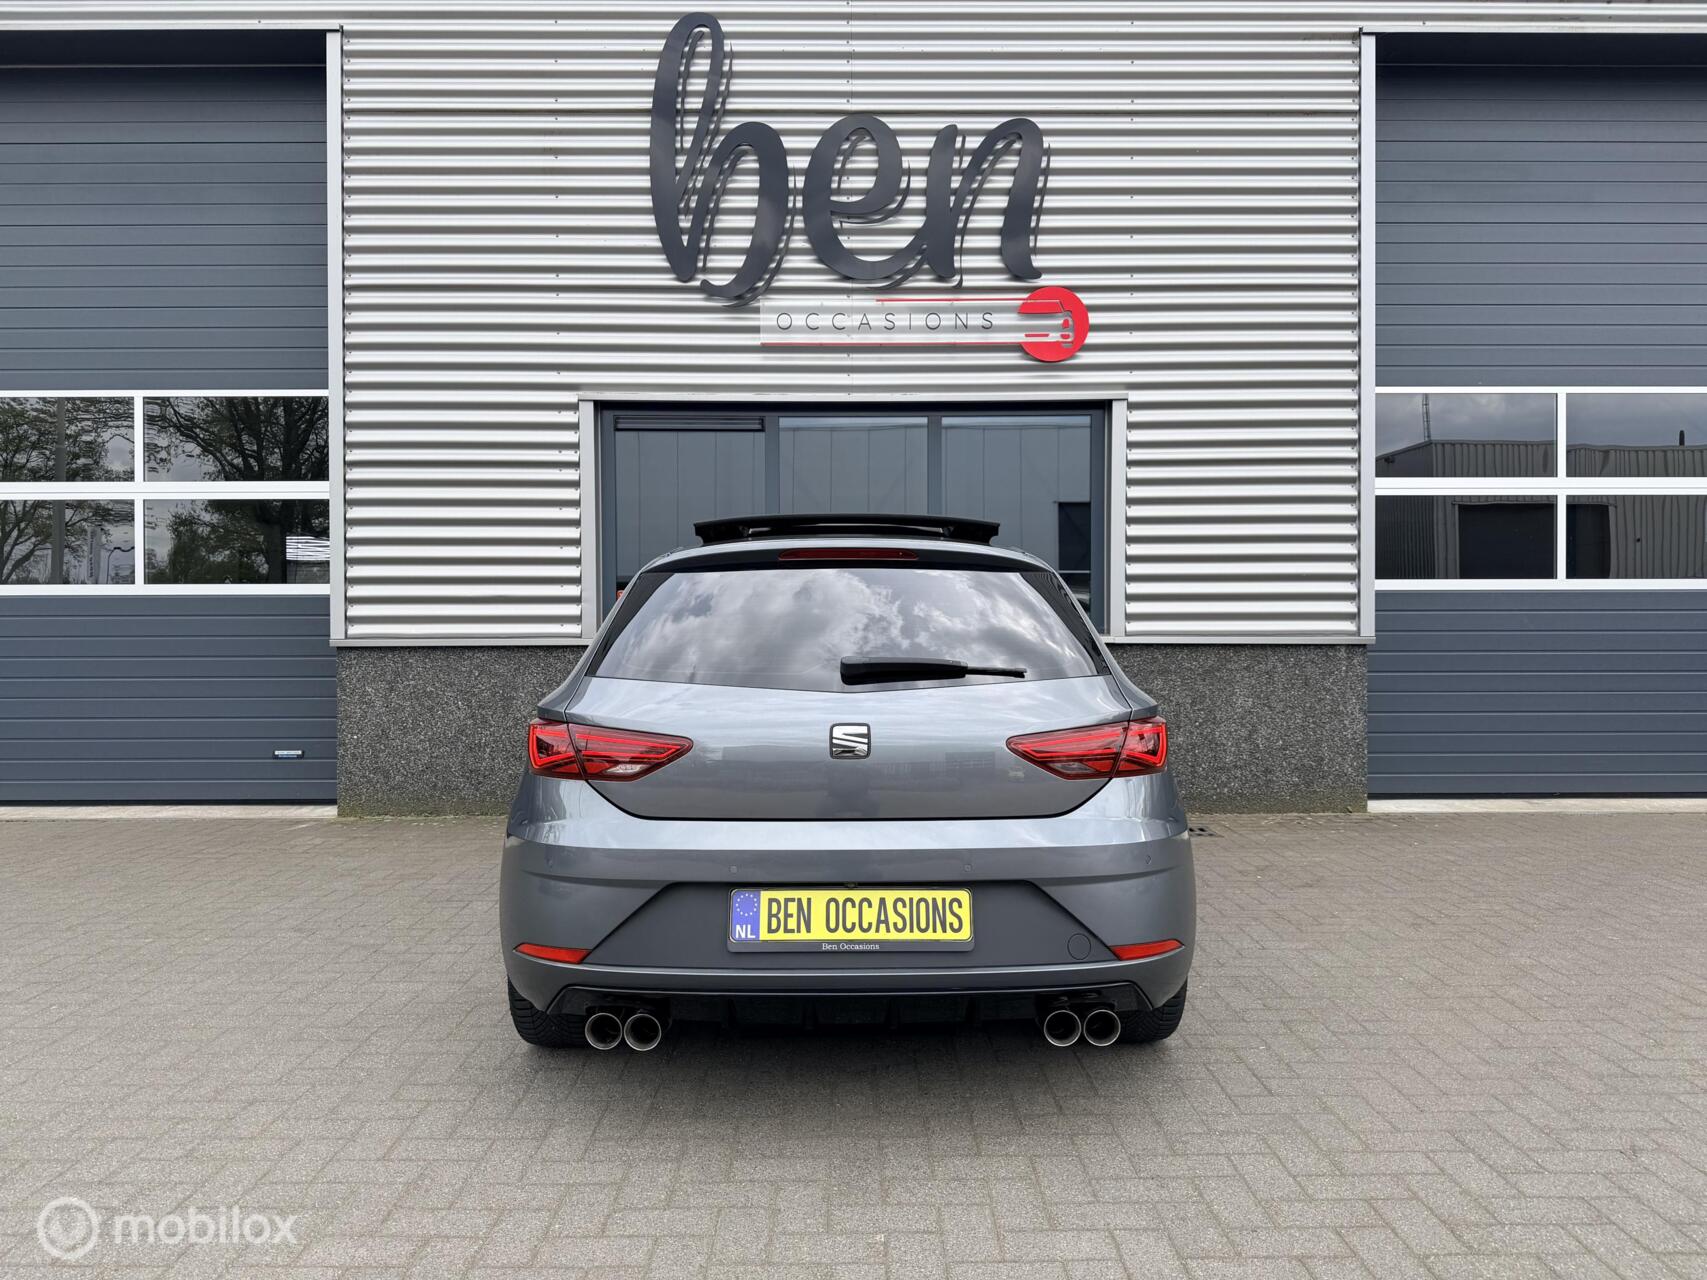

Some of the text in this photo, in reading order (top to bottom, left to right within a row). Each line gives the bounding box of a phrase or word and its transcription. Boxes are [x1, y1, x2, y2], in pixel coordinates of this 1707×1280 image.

[650, 12, 1043, 298] ben
[776, 311, 995, 331] OCCASIONS
[767, 897, 963, 934] BEN OCCASIONS
[735, 924, 756, 939] NL
